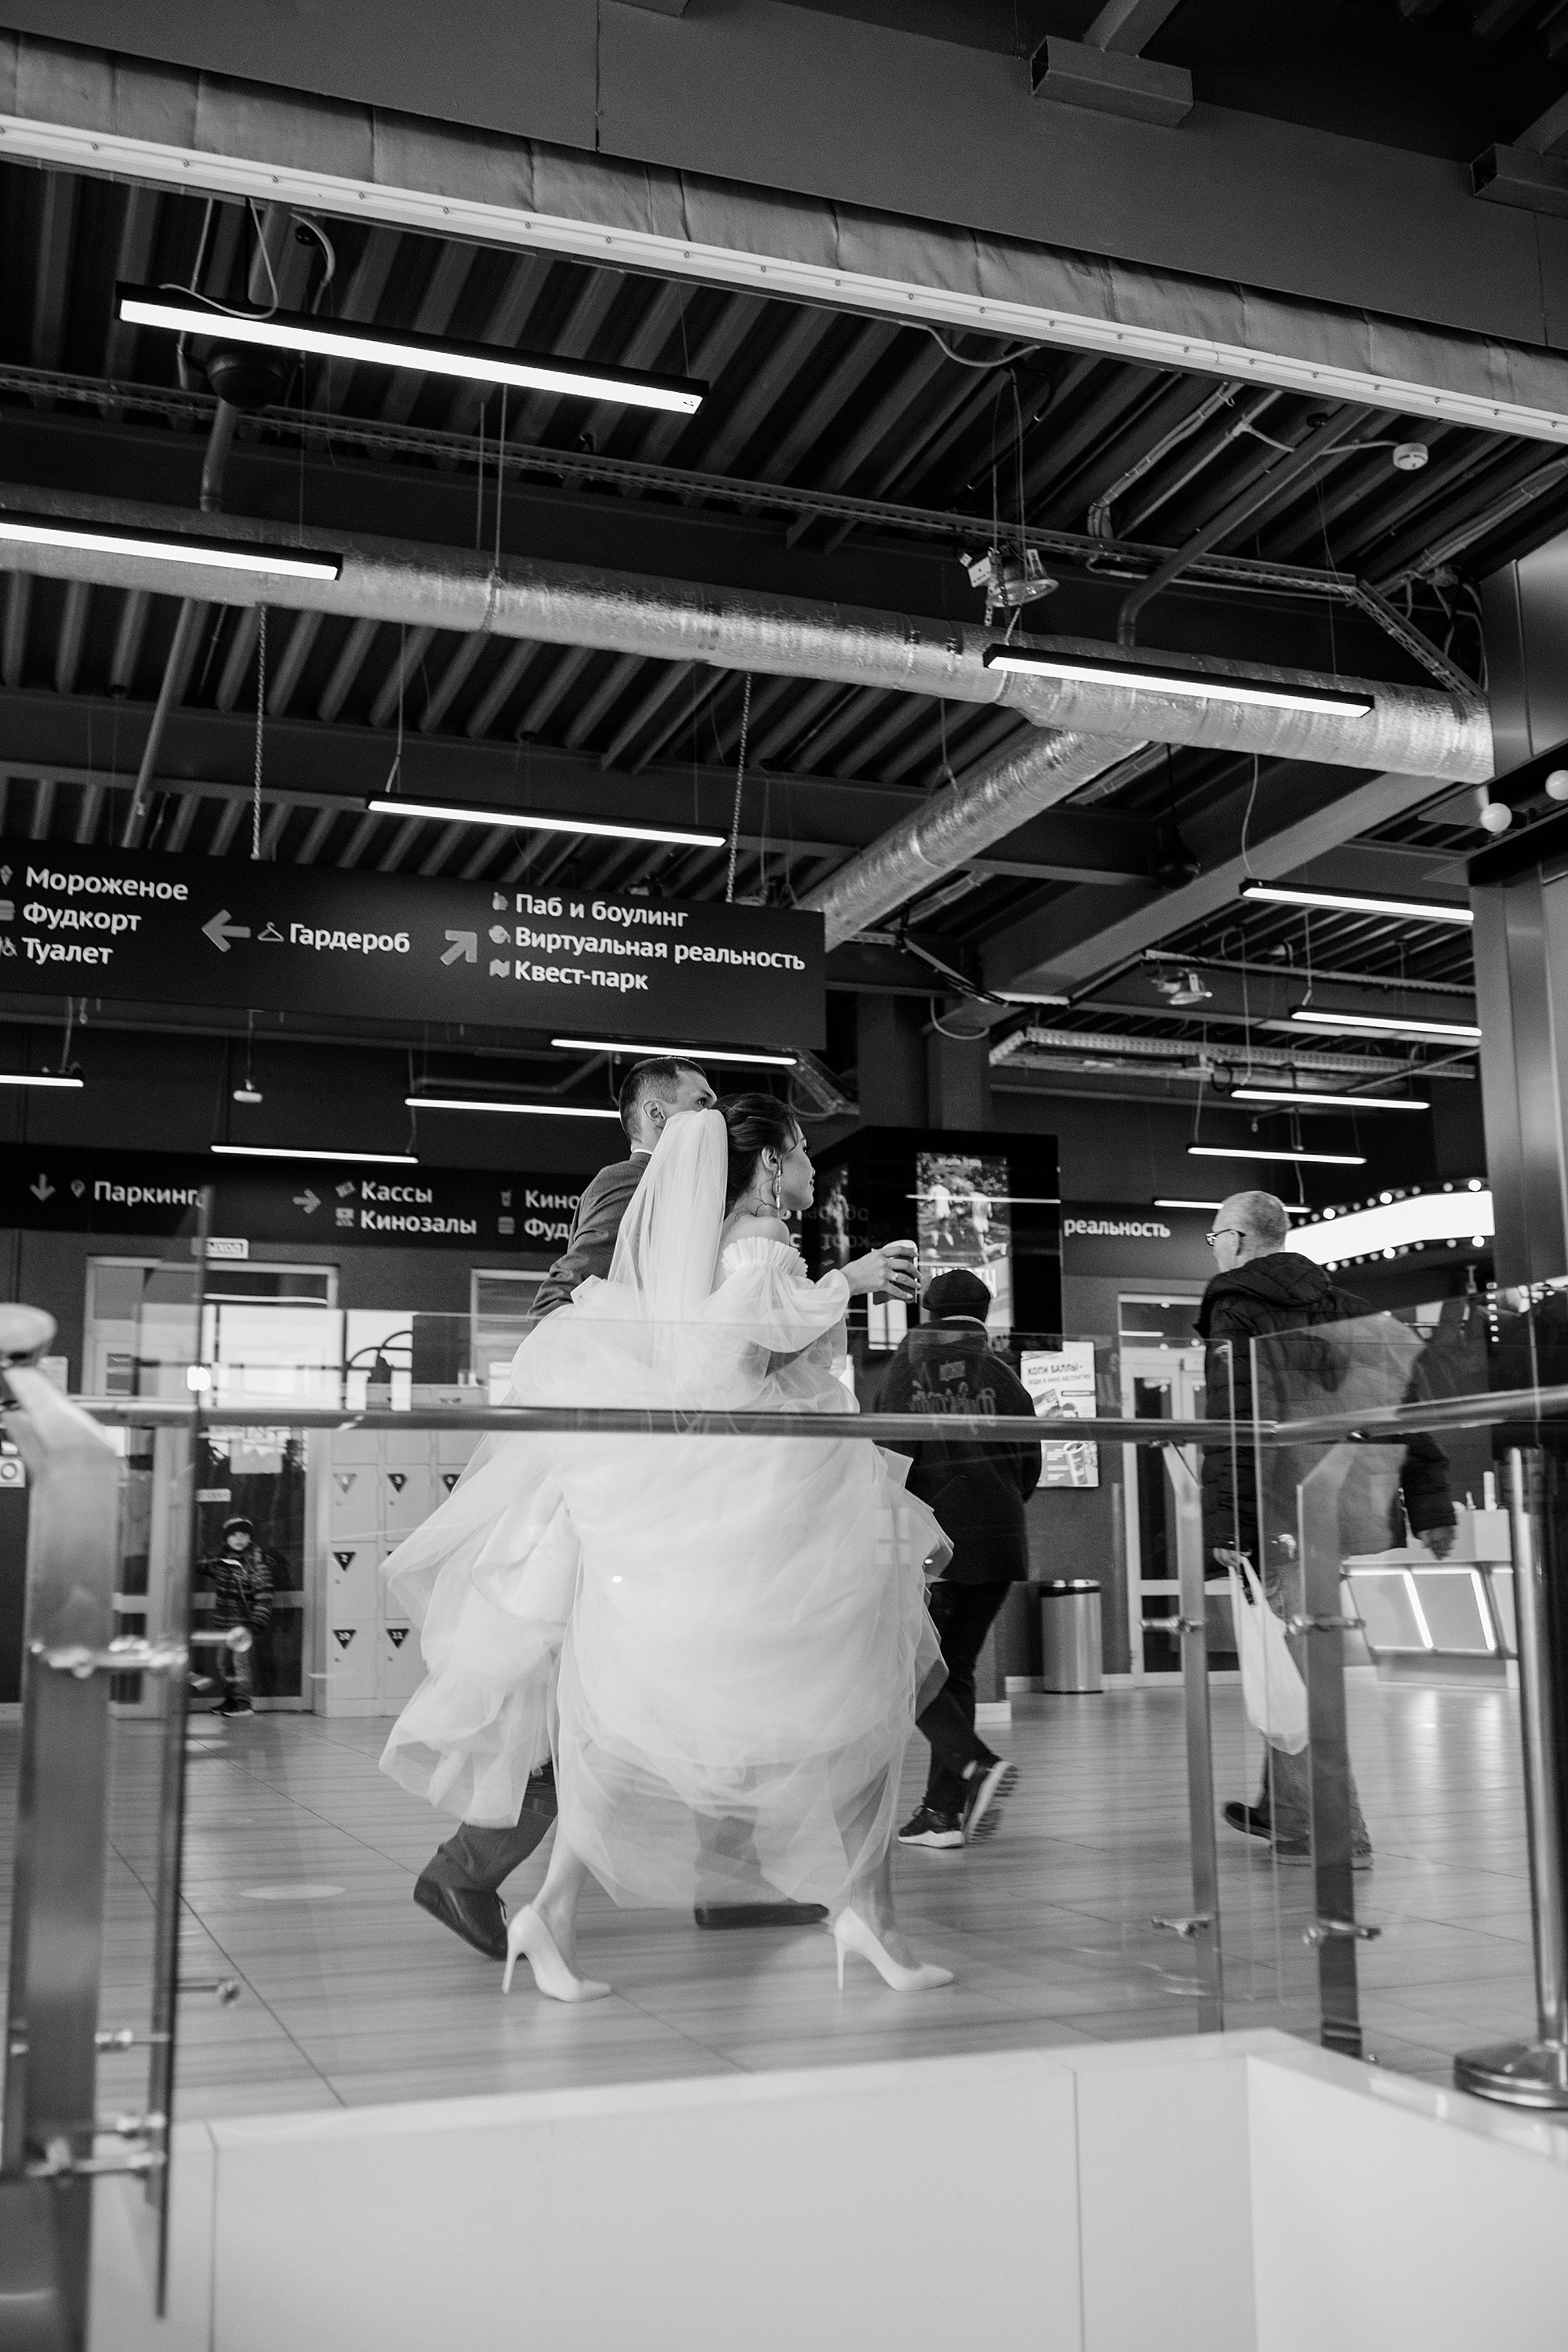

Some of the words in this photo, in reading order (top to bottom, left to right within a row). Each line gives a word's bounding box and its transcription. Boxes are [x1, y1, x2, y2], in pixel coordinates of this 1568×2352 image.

[26, 866, 189, 901] Мороженое
[22, 902, 142, 935] Фудкорт
[515, 893, 563, 917] Паб
[569, 902, 585, 919] и
[591, 900, 689, 927] боулинг
[21, 936, 114, 965] Туалет
[290, 923, 411, 954] Гардероб
[514, 926, 669, 959] Виртуальная
[673, 944, 806, 971] реальность
[514, 960, 649, 993] Квест-парк
[94, 1181, 199, 1207] Паркинг
[361, 1181, 434, 1203] Кассы
[361, 1209, 477, 1235] Кинозалы
[524, 1218, 572, 1241] Фуд
[1063, 1218, 1172, 1238] реальность
